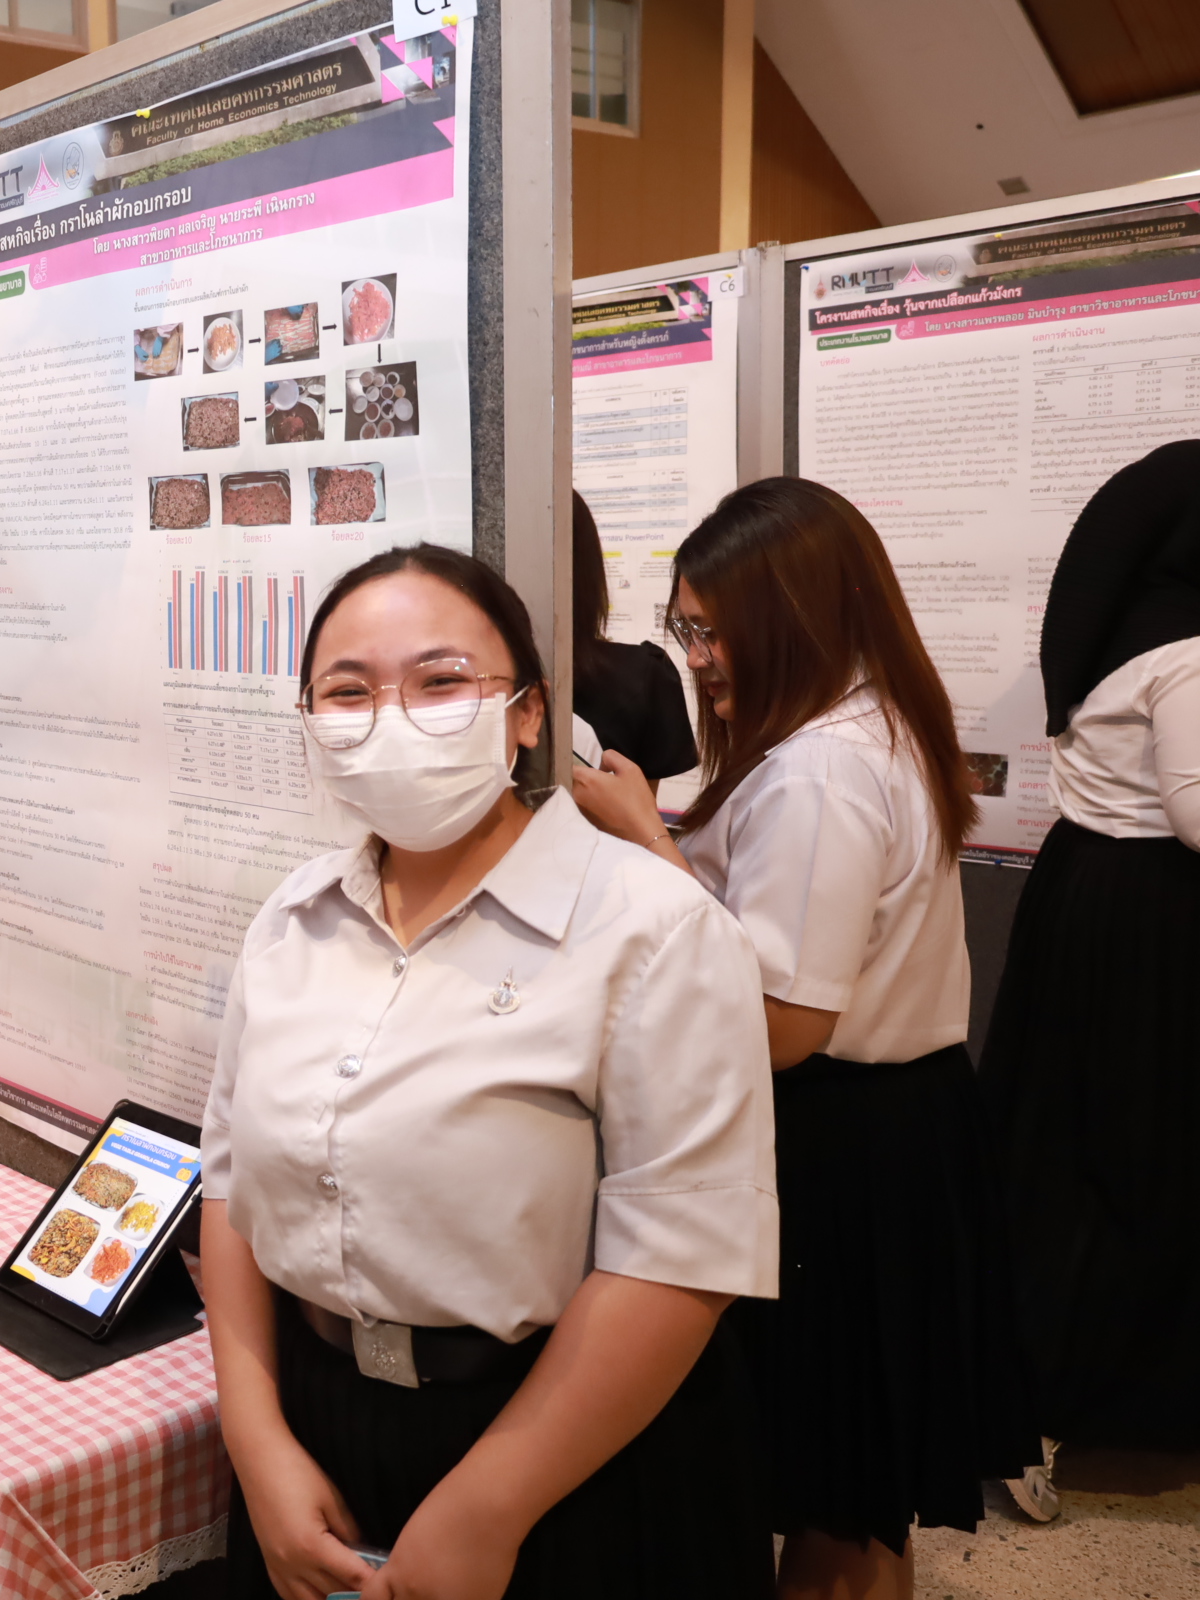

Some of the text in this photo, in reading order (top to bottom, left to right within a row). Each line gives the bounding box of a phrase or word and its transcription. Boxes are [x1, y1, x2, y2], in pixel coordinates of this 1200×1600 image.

[146, 83, 337, 146] Faculty of Home Economics Technology
[60, 186, 192, 235] กราโนล่าผักอบกรอบ
[94, 237, 109, 254] โดย
[178, 214, 216, 235] ผลเจริญ
[1012, 250, 1041, 259] Faculty
[1059, 245, 1083, 253] Home
[1086, 238, 1132, 249] Economics
[1134, 231, 1180, 243] Technology
[140, 228, 263, 266] สาขาอาหารและโภชนาการ
[135, 278, 192, 297] ผลการดำเนินการ
[719, 278, 736, 292] C6
[831, 266, 894, 291] RMUTT
[815, 285, 1023, 325] โครงงานสหกิจเรื่อง วุ้นจากเปลือกแก้วมังกร
[924, 320, 941, 331] โดย
[1028, 306, 1066, 322] มินบำรุง
[1032, 327, 1106, 342] ผลการดำเนินงาน
[819, 356, 850, 367] บทคัดย่อ
[243, 532, 272, 543] ร้อยละ15
[331, 529, 364, 542] ร้อยละ20
[625, 533, 664, 542] PowerPoint
